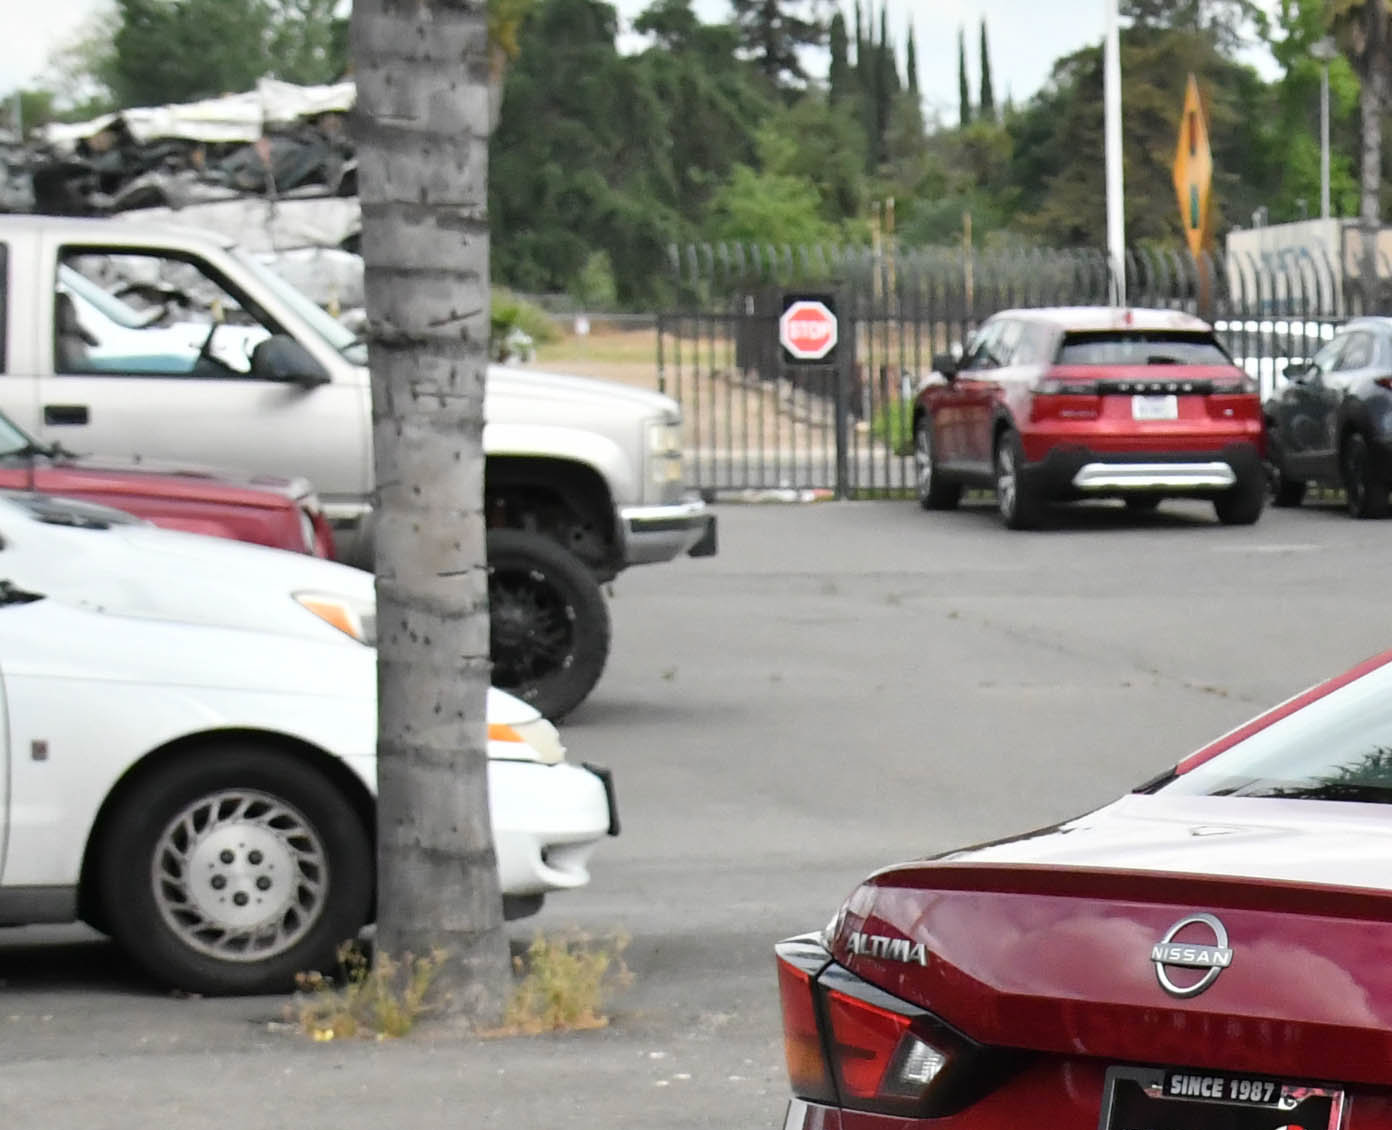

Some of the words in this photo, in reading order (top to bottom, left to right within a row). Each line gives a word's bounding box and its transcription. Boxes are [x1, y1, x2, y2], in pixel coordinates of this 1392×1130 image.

[790, 319, 831, 341] STOP
[847, 932, 928, 967] ALTIMA
[1151, 945, 1229, 966] NISSAN
[1170, 1074, 1224, 1099] SINCE
[1230, 1080, 1275, 1102] 1987
